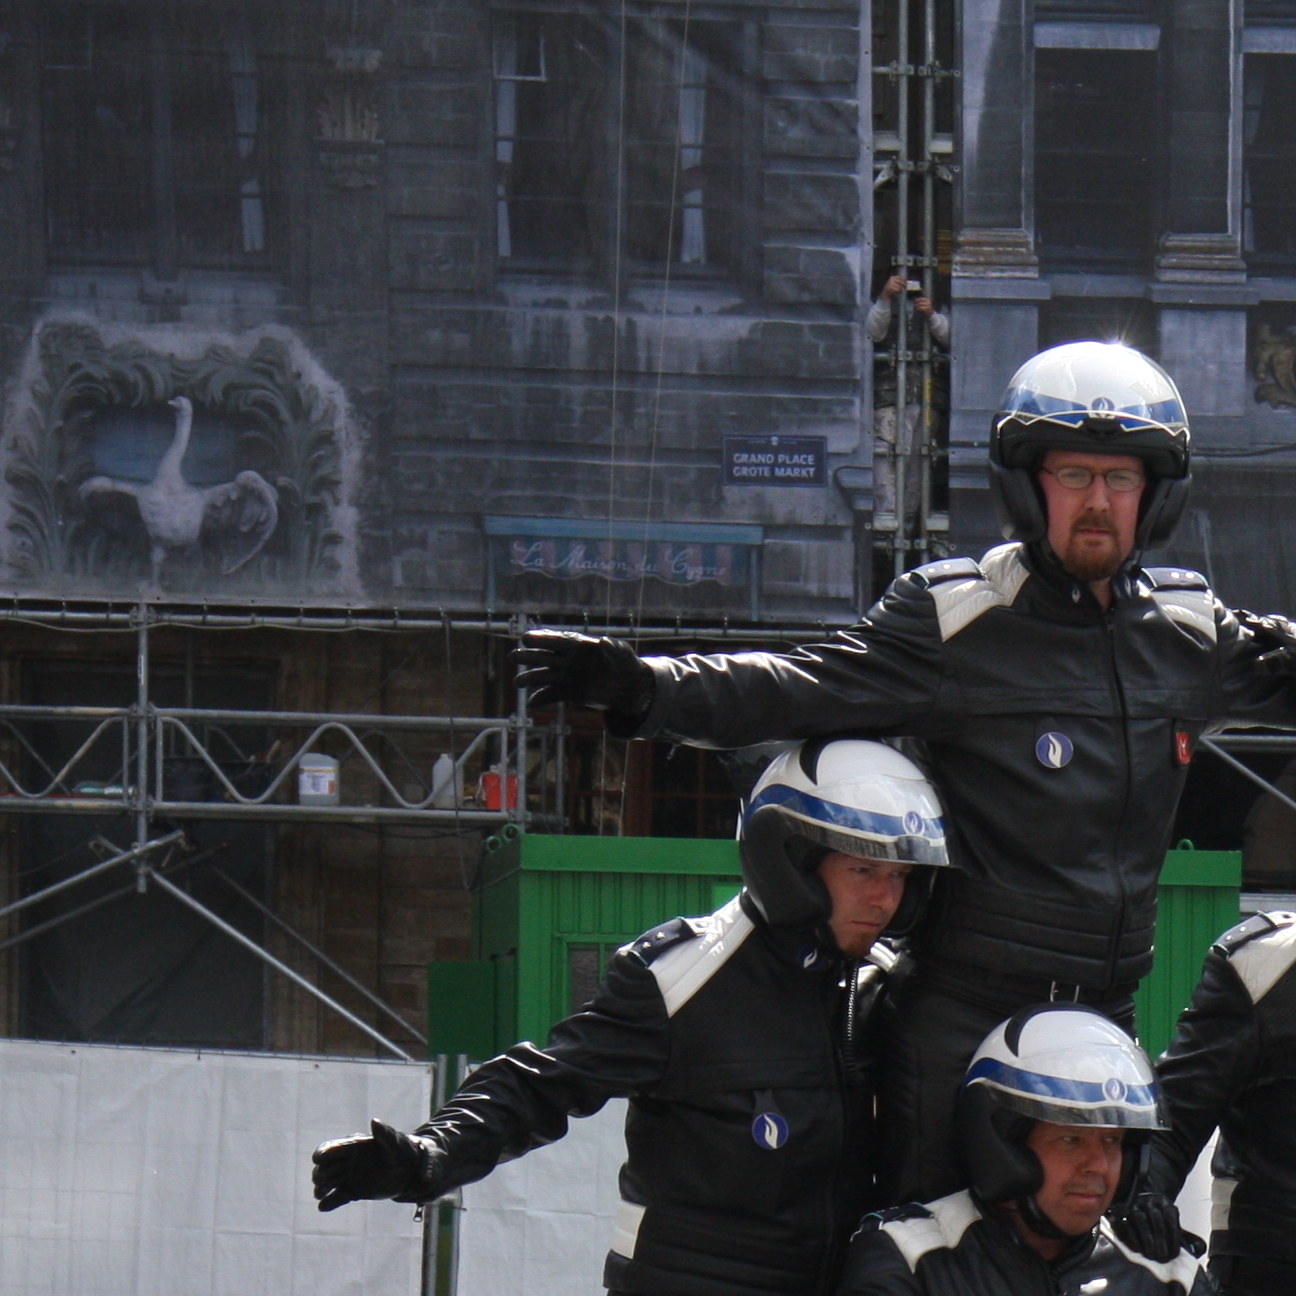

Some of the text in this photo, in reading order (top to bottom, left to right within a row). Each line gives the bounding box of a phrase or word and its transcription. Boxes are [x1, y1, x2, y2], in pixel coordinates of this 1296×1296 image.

[733, 453, 815, 465] GRAND PLACE
[732, 466, 816, 478] GROTE MARKT
[510, 540, 544, 567] La
[549, 543, 627, 570] Maison
[664, 546, 727, 581] Cygne
